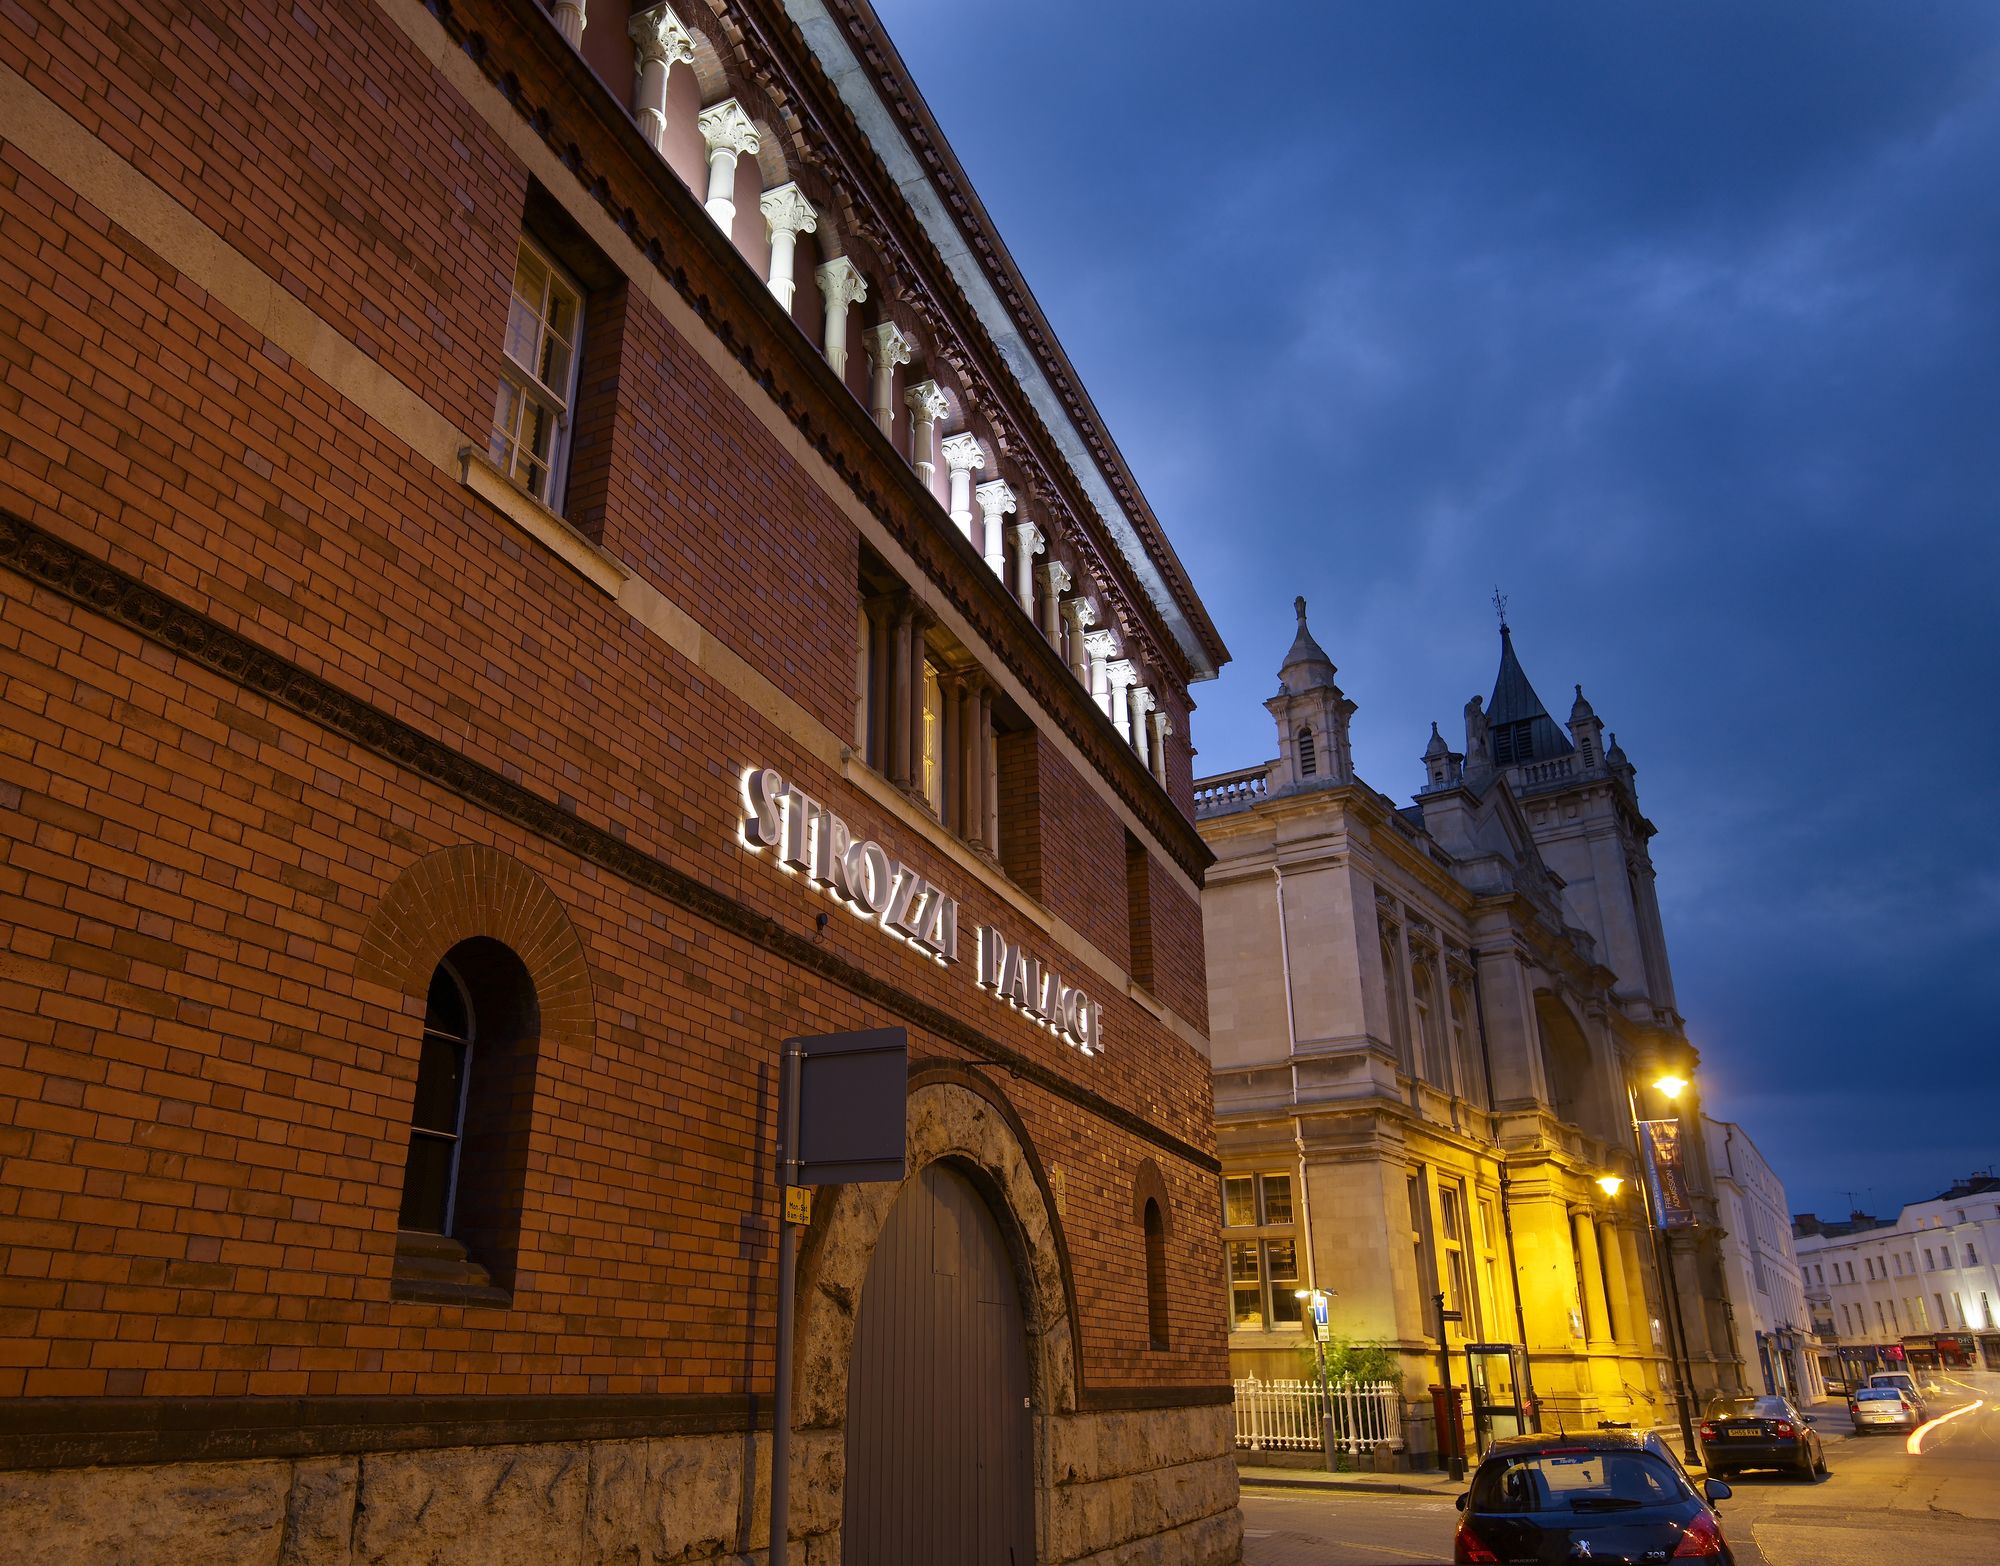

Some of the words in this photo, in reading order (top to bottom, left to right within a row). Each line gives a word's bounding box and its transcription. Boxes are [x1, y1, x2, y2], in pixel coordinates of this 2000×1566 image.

[743, 767, 961, 964] STROZZI
[978, 924, 1105, 1055] PALACE
[1663, 1191, 1672, 1209] FREE
[1665, 1169, 1681, 1208] ADMISSION
[1647, 1551, 1666, 1559] 308
